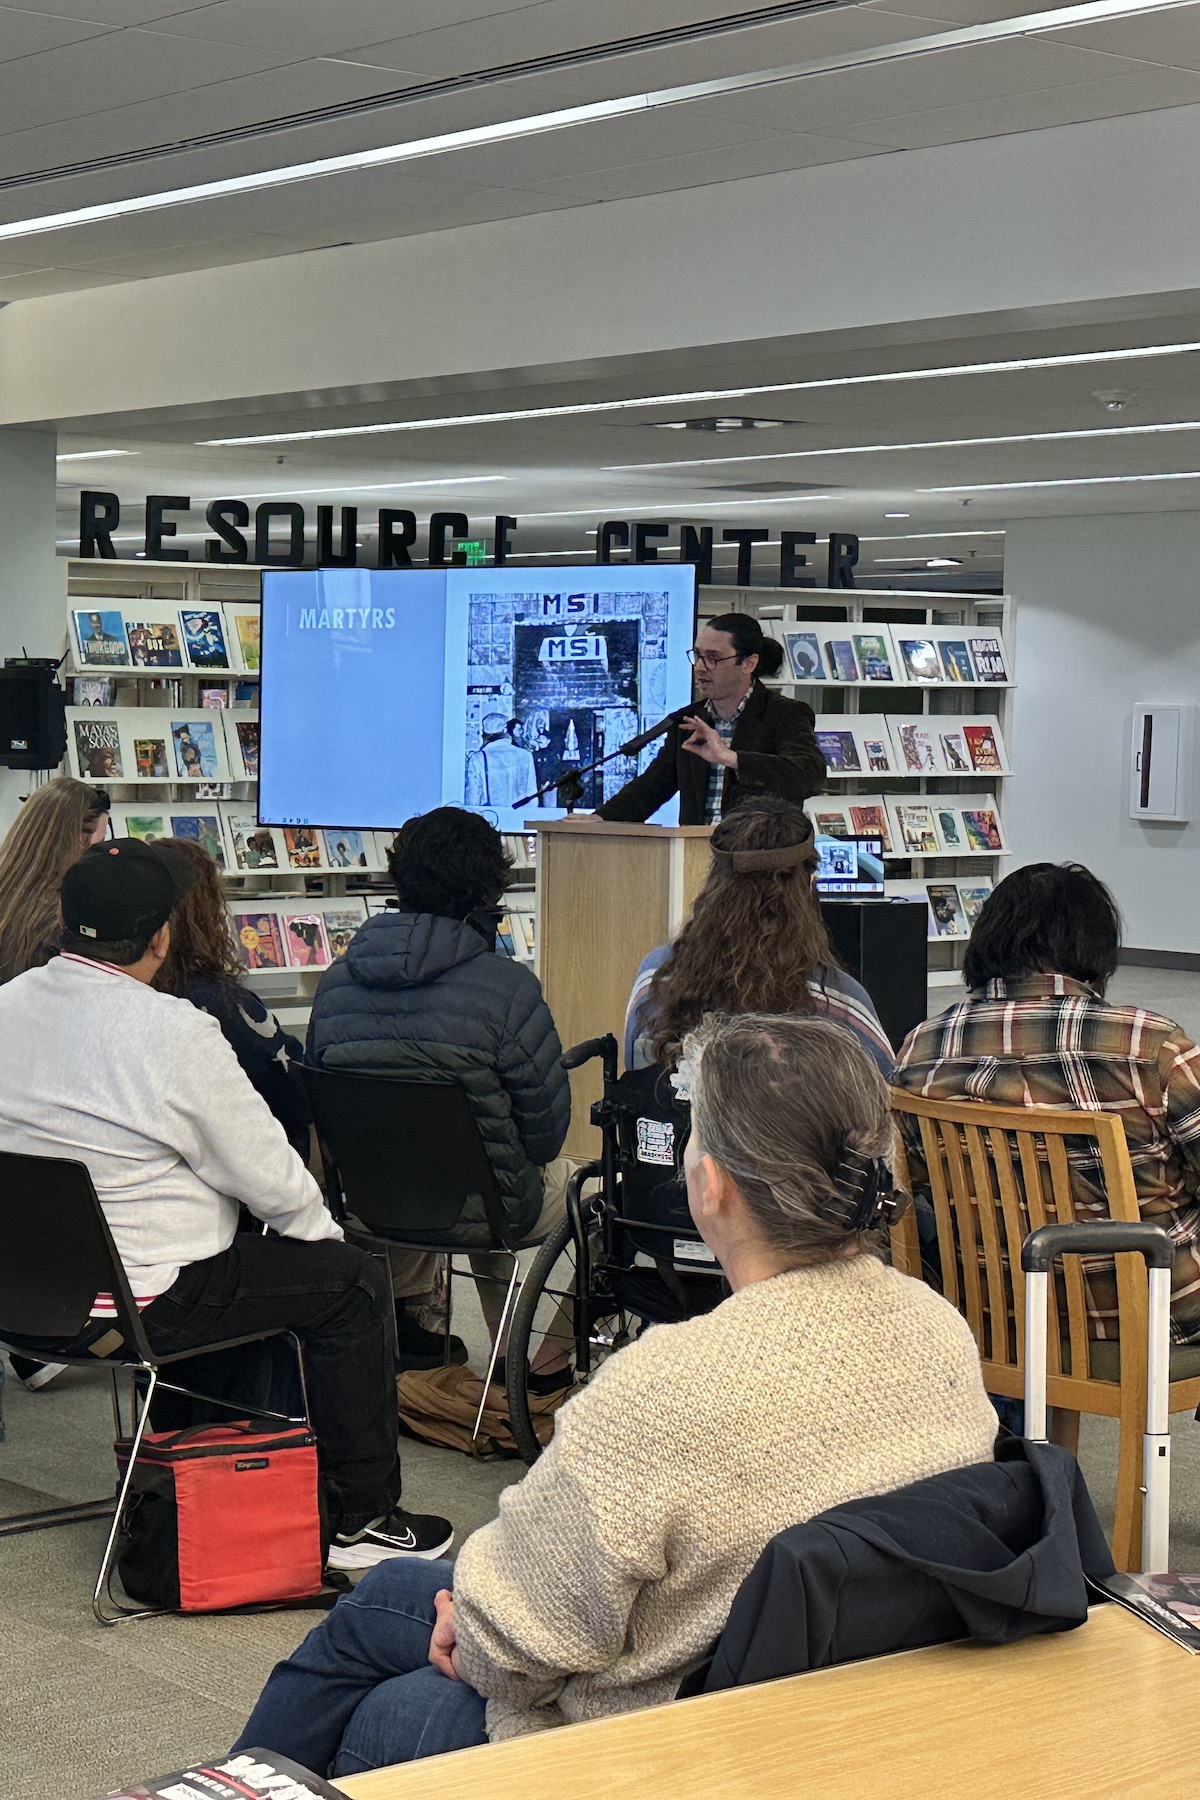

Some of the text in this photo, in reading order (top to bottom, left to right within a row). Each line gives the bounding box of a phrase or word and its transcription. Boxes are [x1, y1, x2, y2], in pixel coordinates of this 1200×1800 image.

[80, 491, 860, 589] RESOURCE CENTER
[543, 593, 599, 615] MSI
[299, 607, 396, 630] MARTYRS
[548, 638, 600, 658] MSI
